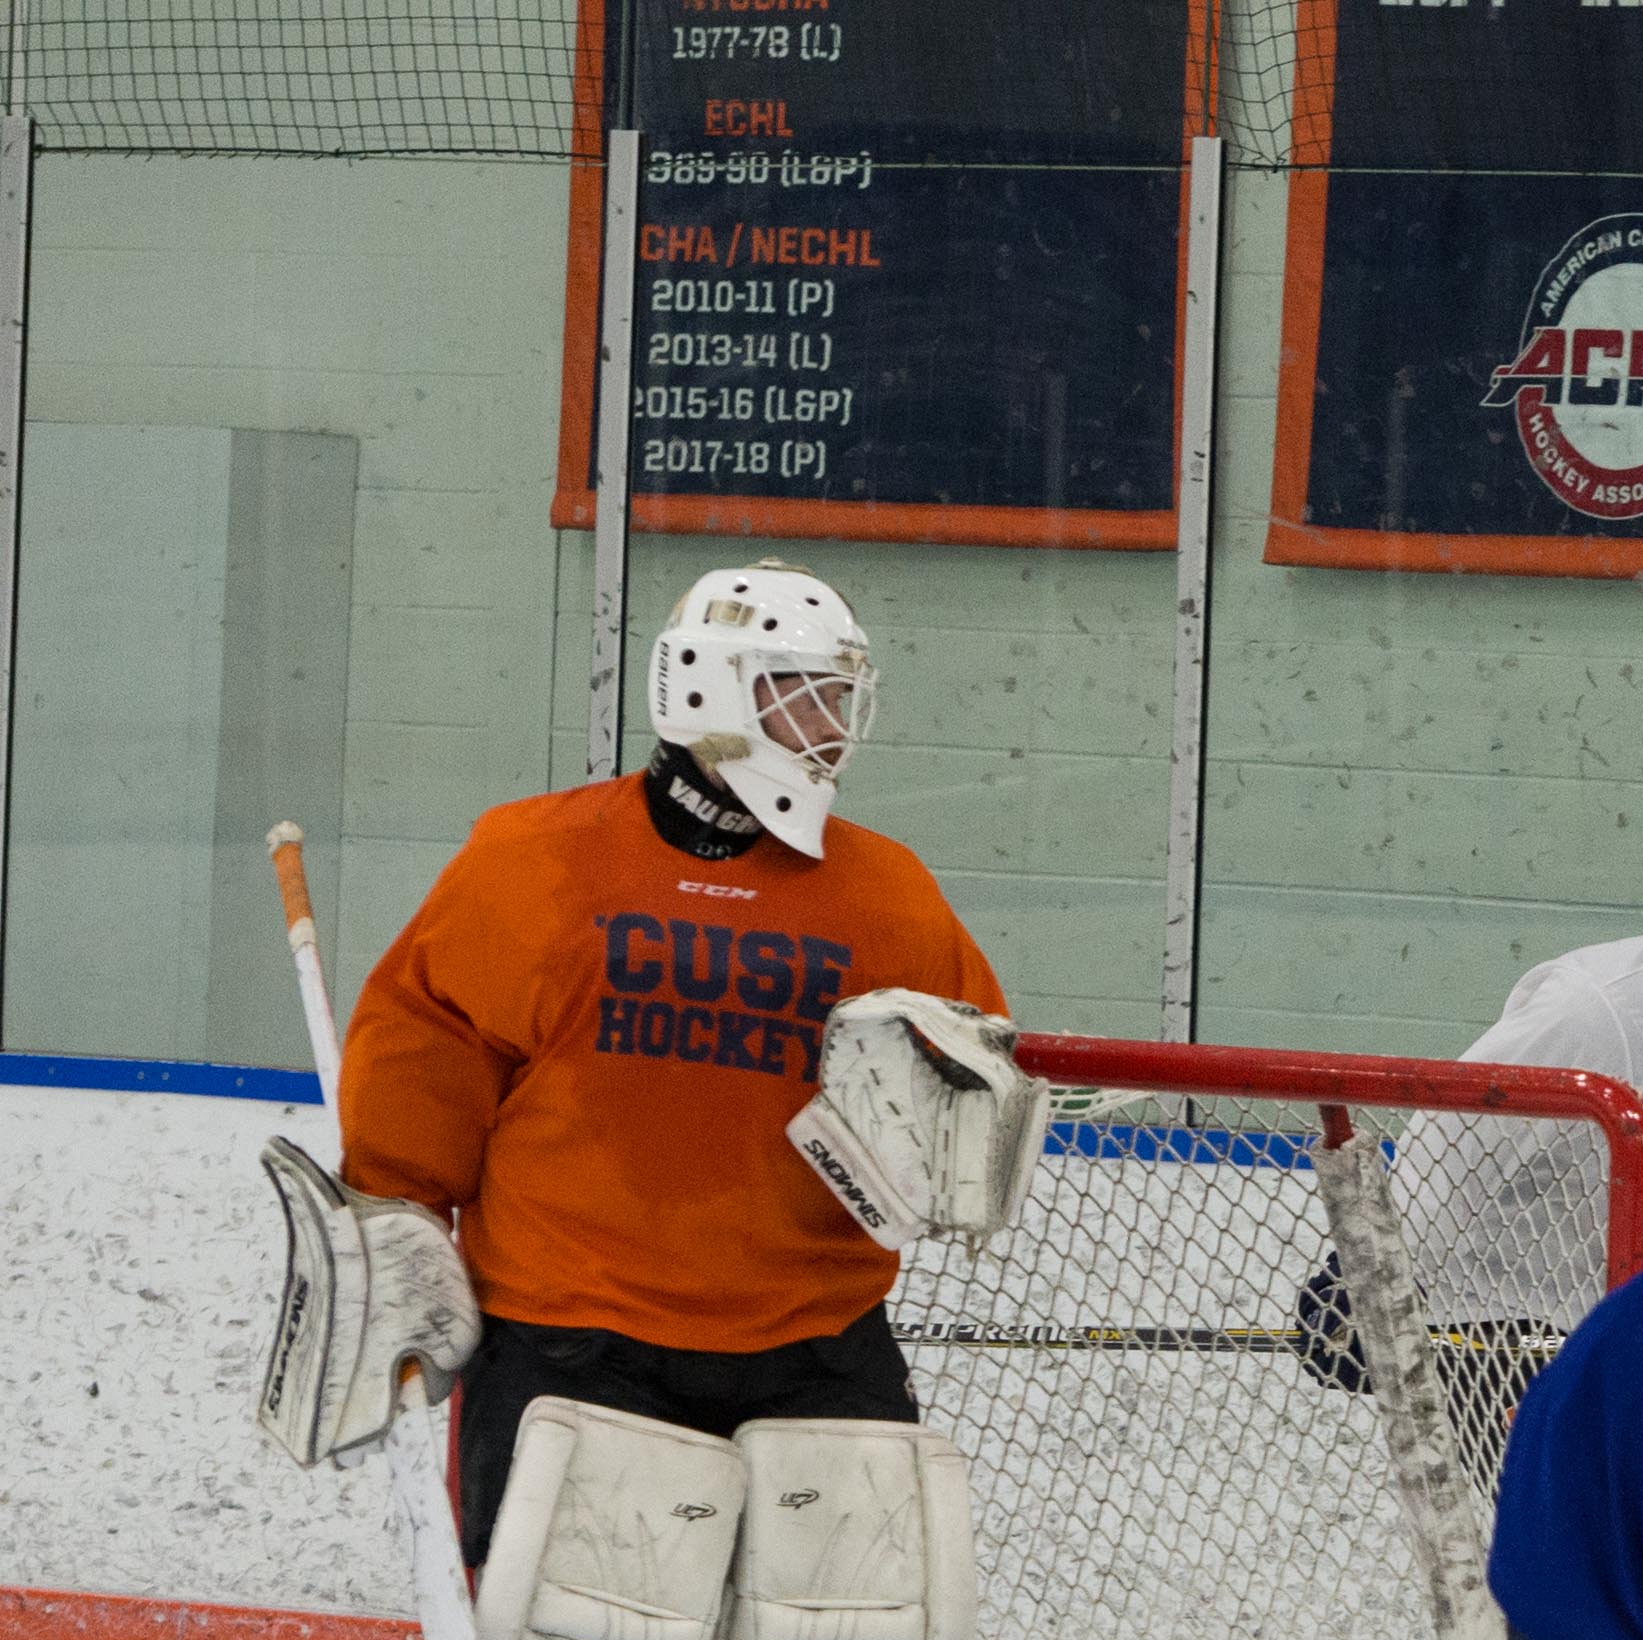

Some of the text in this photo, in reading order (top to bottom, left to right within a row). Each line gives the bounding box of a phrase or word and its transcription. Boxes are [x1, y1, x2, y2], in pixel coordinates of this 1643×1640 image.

[673, 22, 842, 61] 1977-78 (L)
[704, 99, 794, 137] ECHL
[639, 223, 718, 263] CHA
[751, 227, 881, 267] NECHL
[1539, 230, 1623, 318] AMERICAN
[651, 278, 834, 317] 2010-11 (P)
[648, 332, 832, 372] 2013-14 (L)
[764, 385, 854, 426] (L&P)
[644, 439, 827, 479] 2017-18 (P)
[1529, 413, 1590, 493] HOCKEY
[678, 879, 758, 900] CCM
[803, 1139, 887, 1228] SIMMONS
